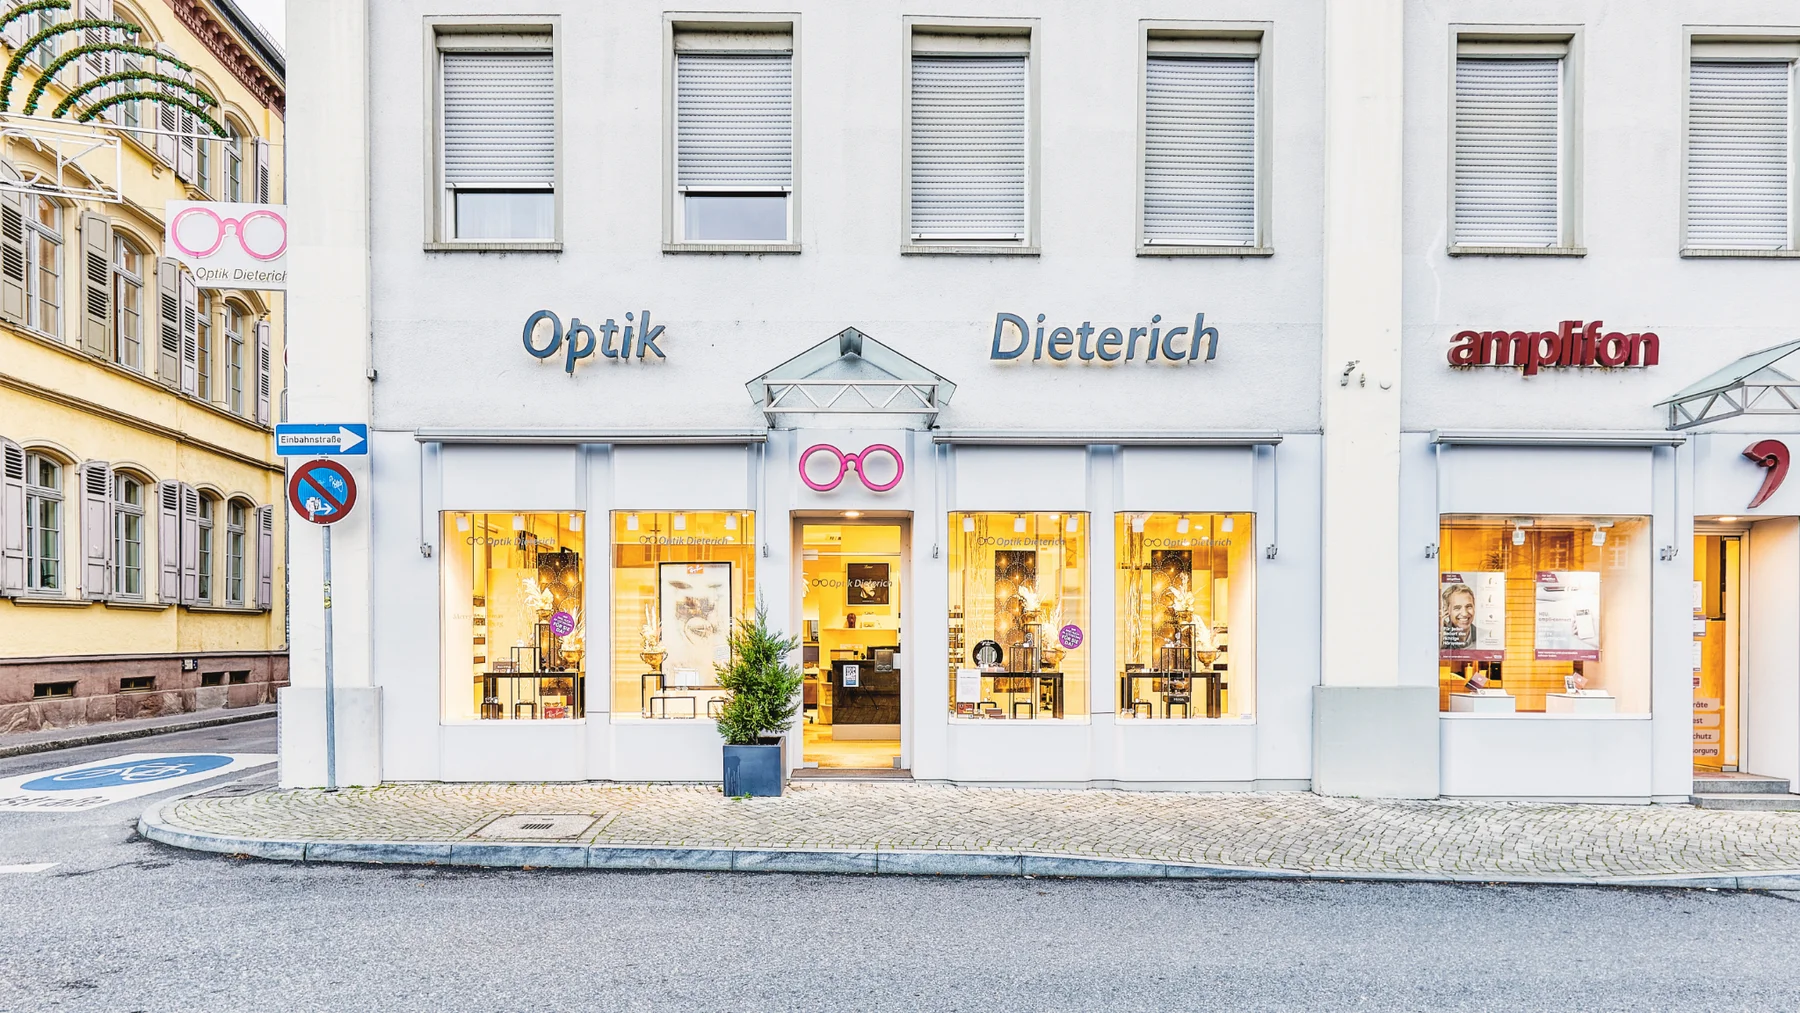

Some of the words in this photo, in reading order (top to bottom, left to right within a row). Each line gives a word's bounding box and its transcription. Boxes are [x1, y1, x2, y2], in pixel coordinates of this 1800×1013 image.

[196, 267, 229, 281] Optik
[522, 309, 666, 374] Optik
[990, 312, 1219, 361] Dieterich
[1447, 320, 1660, 376] amplifon
[280, 435, 341, 443] Einbahnstraße
[486, 537, 512, 547] Optik
[659, 536, 684, 546] Optik
[686, 536, 728, 545] Dieterich
[996, 537, 1022, 547] Optik
[1023, 537, 1065, 546] Dieterich
[1191, 538, 1232, 546] Dieterich
